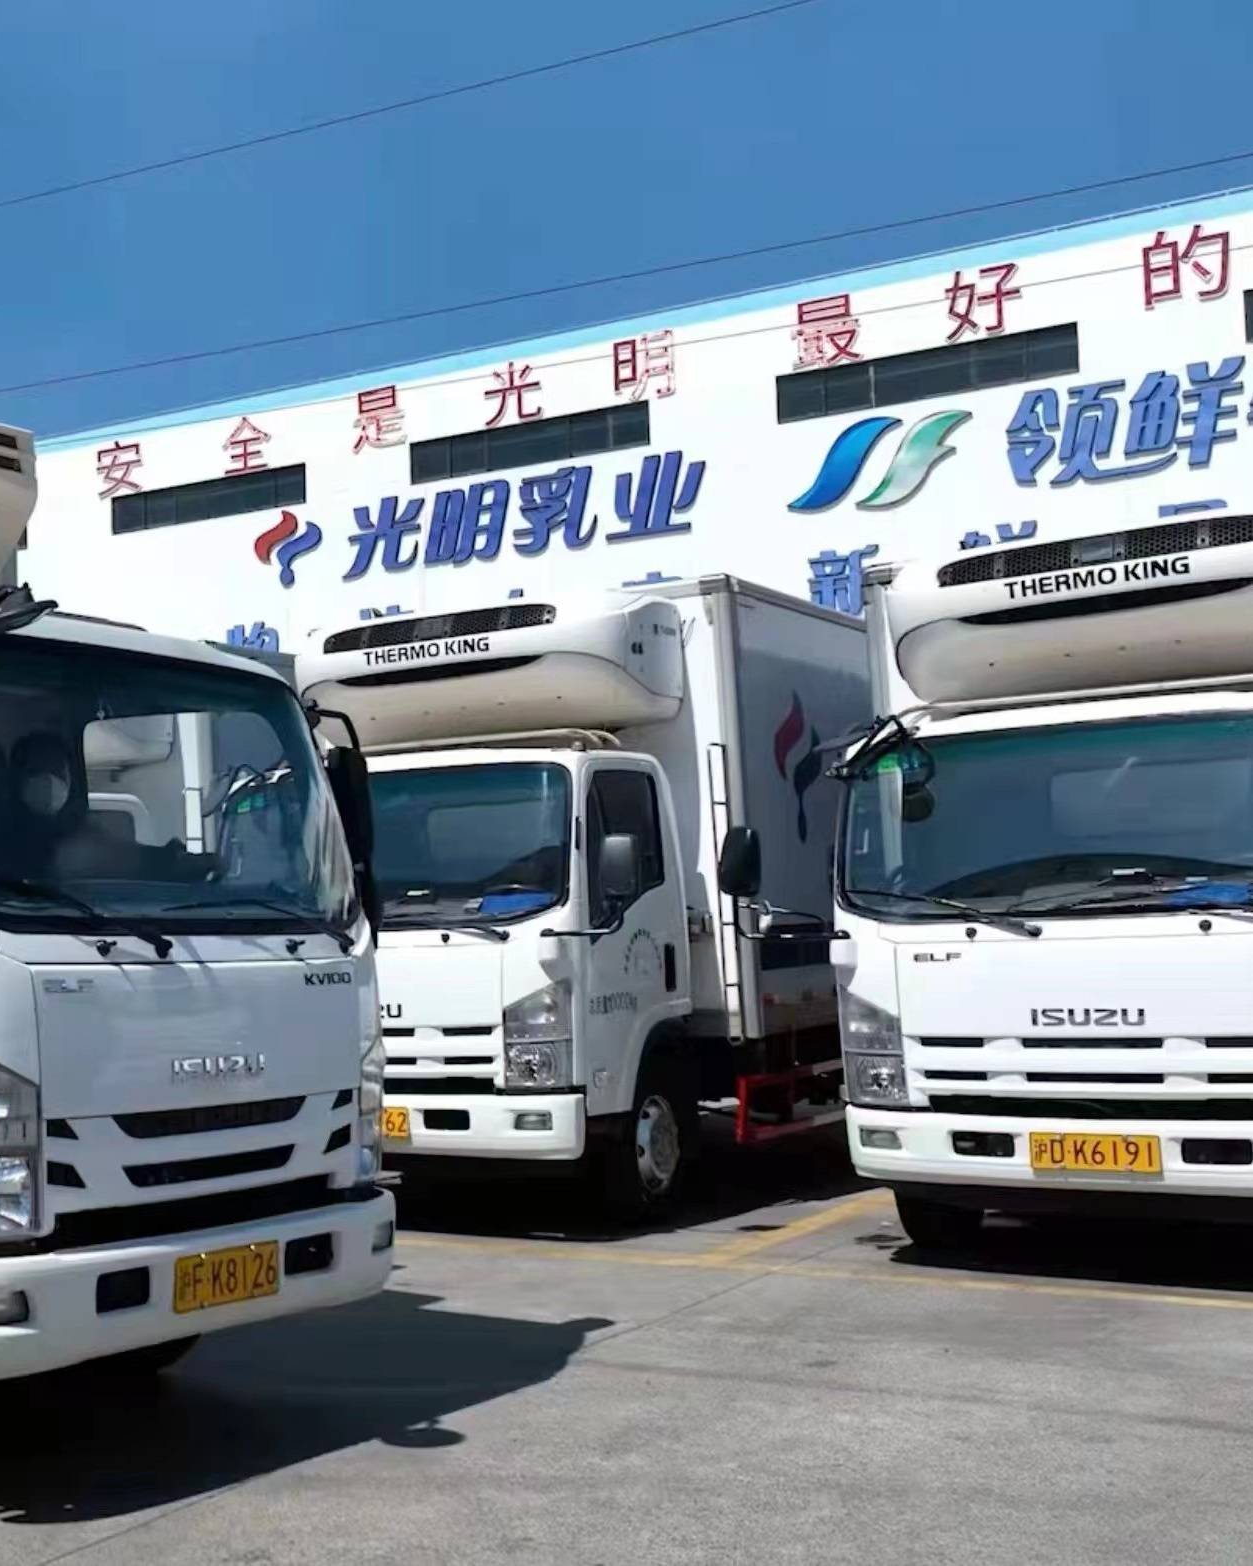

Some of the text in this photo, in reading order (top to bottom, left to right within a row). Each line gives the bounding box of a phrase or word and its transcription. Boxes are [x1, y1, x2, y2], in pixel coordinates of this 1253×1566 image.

[1005, 356, 1253, 487] 领鲜
[342, 450, 707, 583] 光明乳业
[1004, 557, 1191, 600] THERMO KING
[363, 636, 490, 667] THERMO KING
[913, 952, 962, 962] ELF
[304, 972, 352, 986] KV100
[380, 1004, 402, 1019] U
[1030, 1008, 1145, 1027] ISUZU
